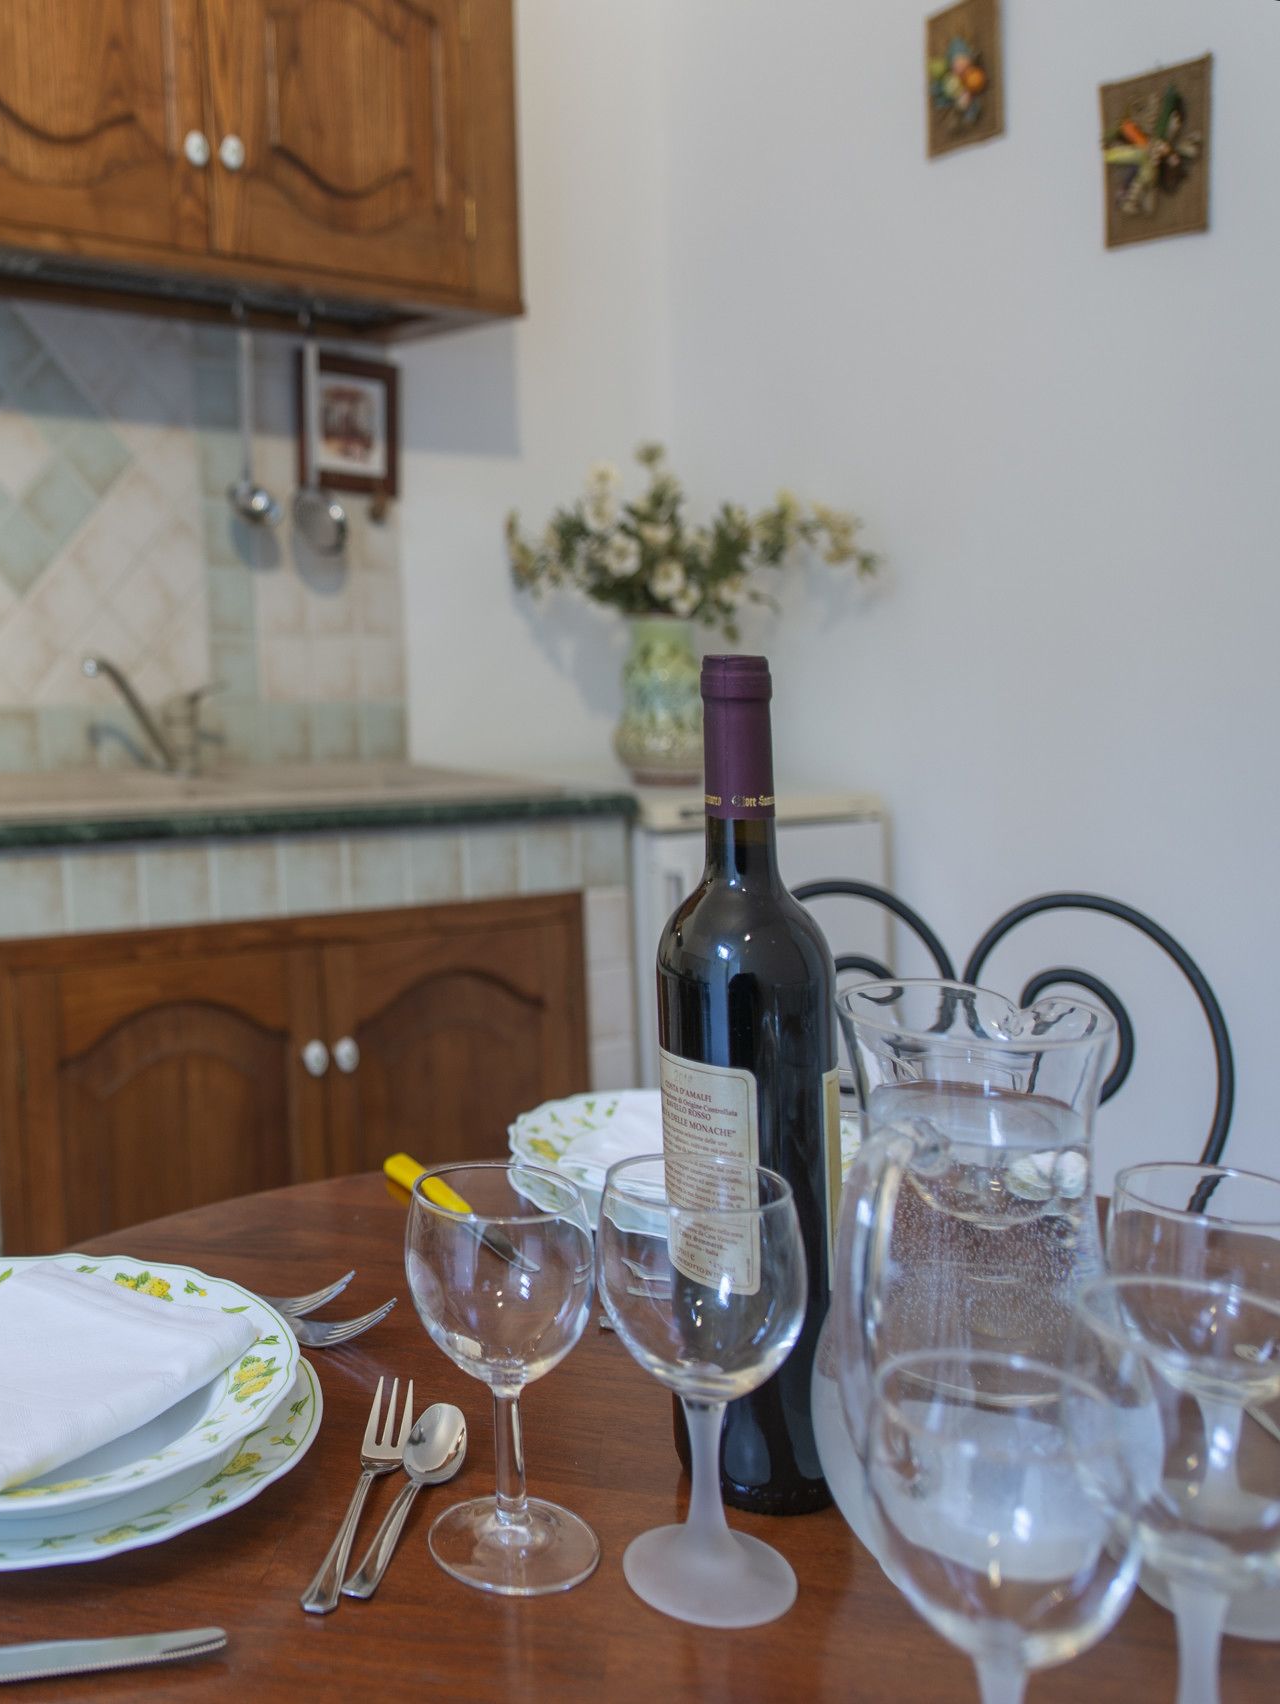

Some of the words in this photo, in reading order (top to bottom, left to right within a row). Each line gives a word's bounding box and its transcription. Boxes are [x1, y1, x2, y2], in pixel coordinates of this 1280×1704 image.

[680, 1087, 712, 1103] D'AMALFI
[683, 1099, 703, 1111] Origine
[703, 1105, 738, 1117] Controllata
[688, 1108, 712, 1121] ROSSO
